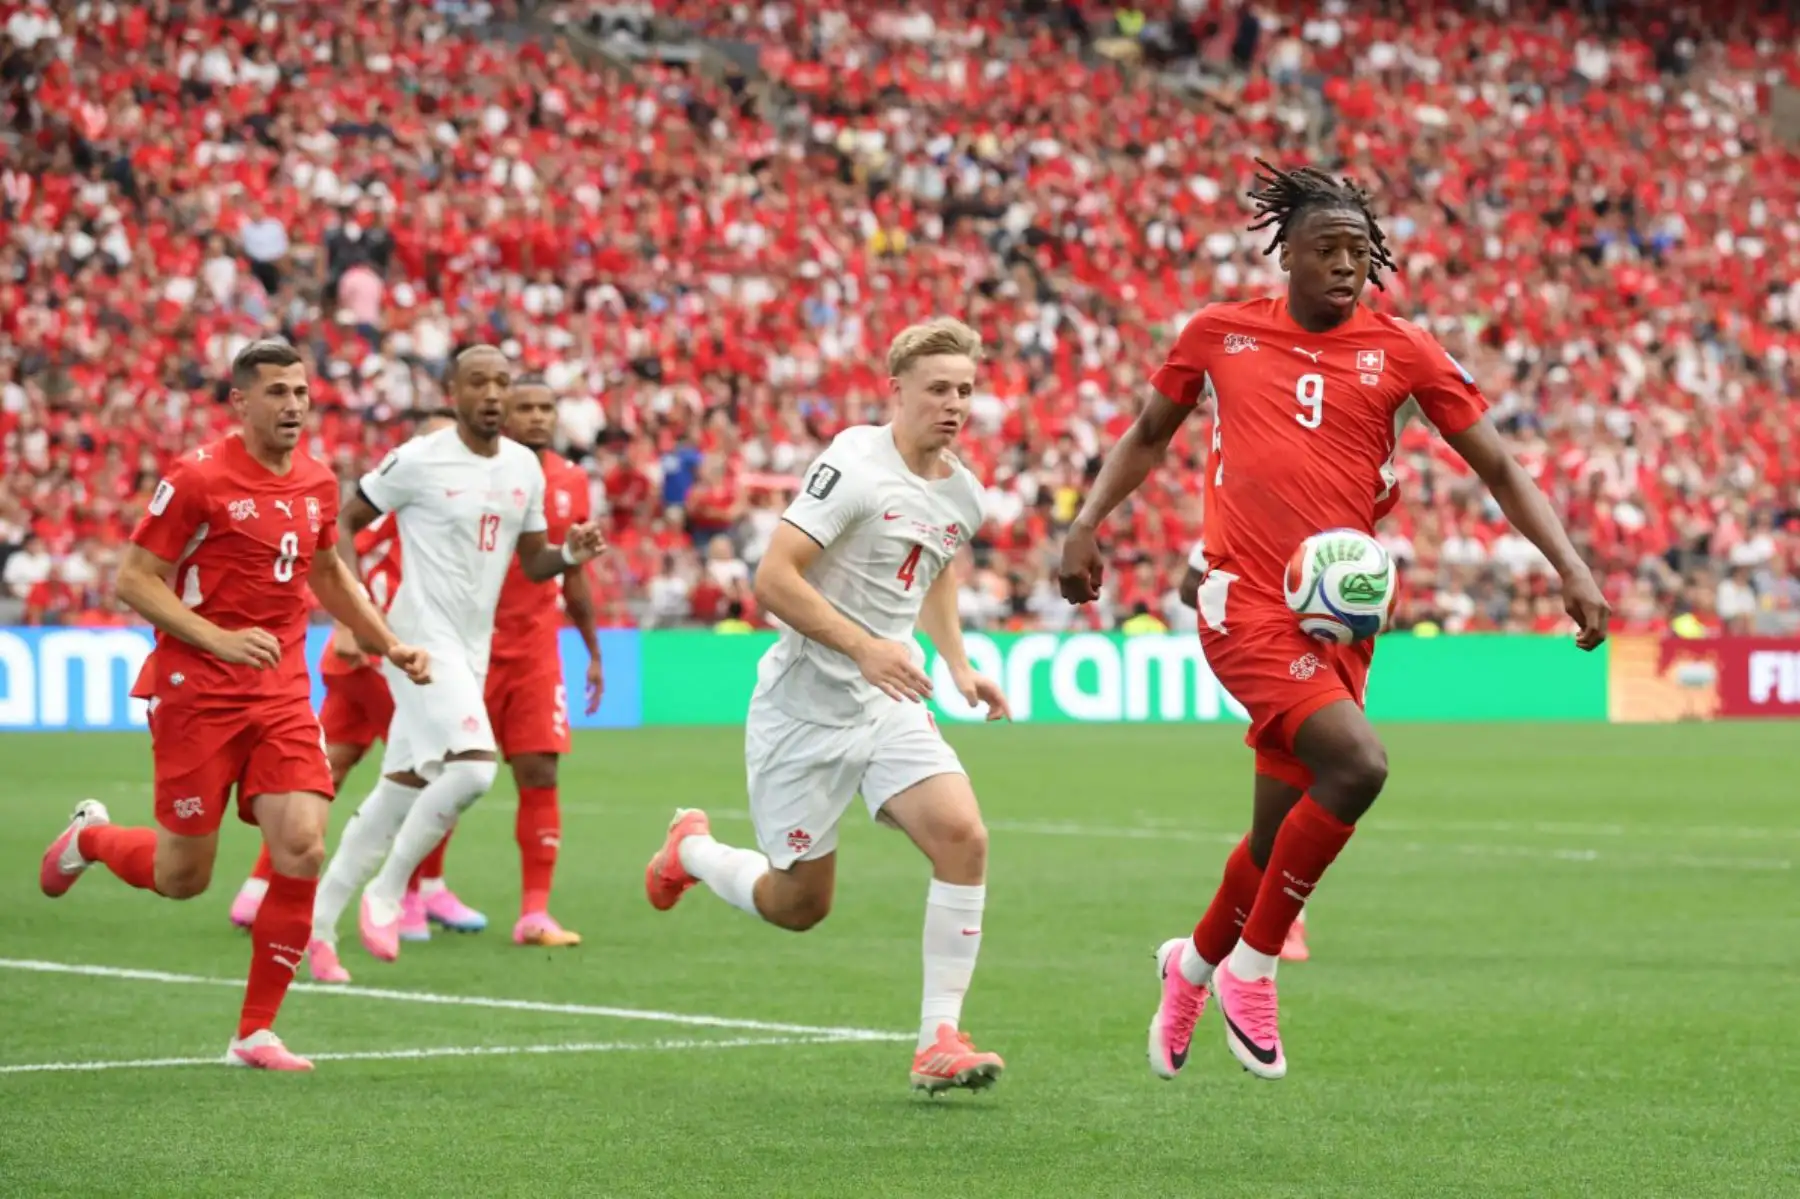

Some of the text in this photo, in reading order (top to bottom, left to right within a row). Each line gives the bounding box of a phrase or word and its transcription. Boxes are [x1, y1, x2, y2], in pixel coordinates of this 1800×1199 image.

[1296, 373, 1324, 428] 9
[274, 531, 298, 582] 8
[478, 514, 500, 551] 13
[896, 544, 923, 591] 4
[931, 632, 1253, 722] aram
